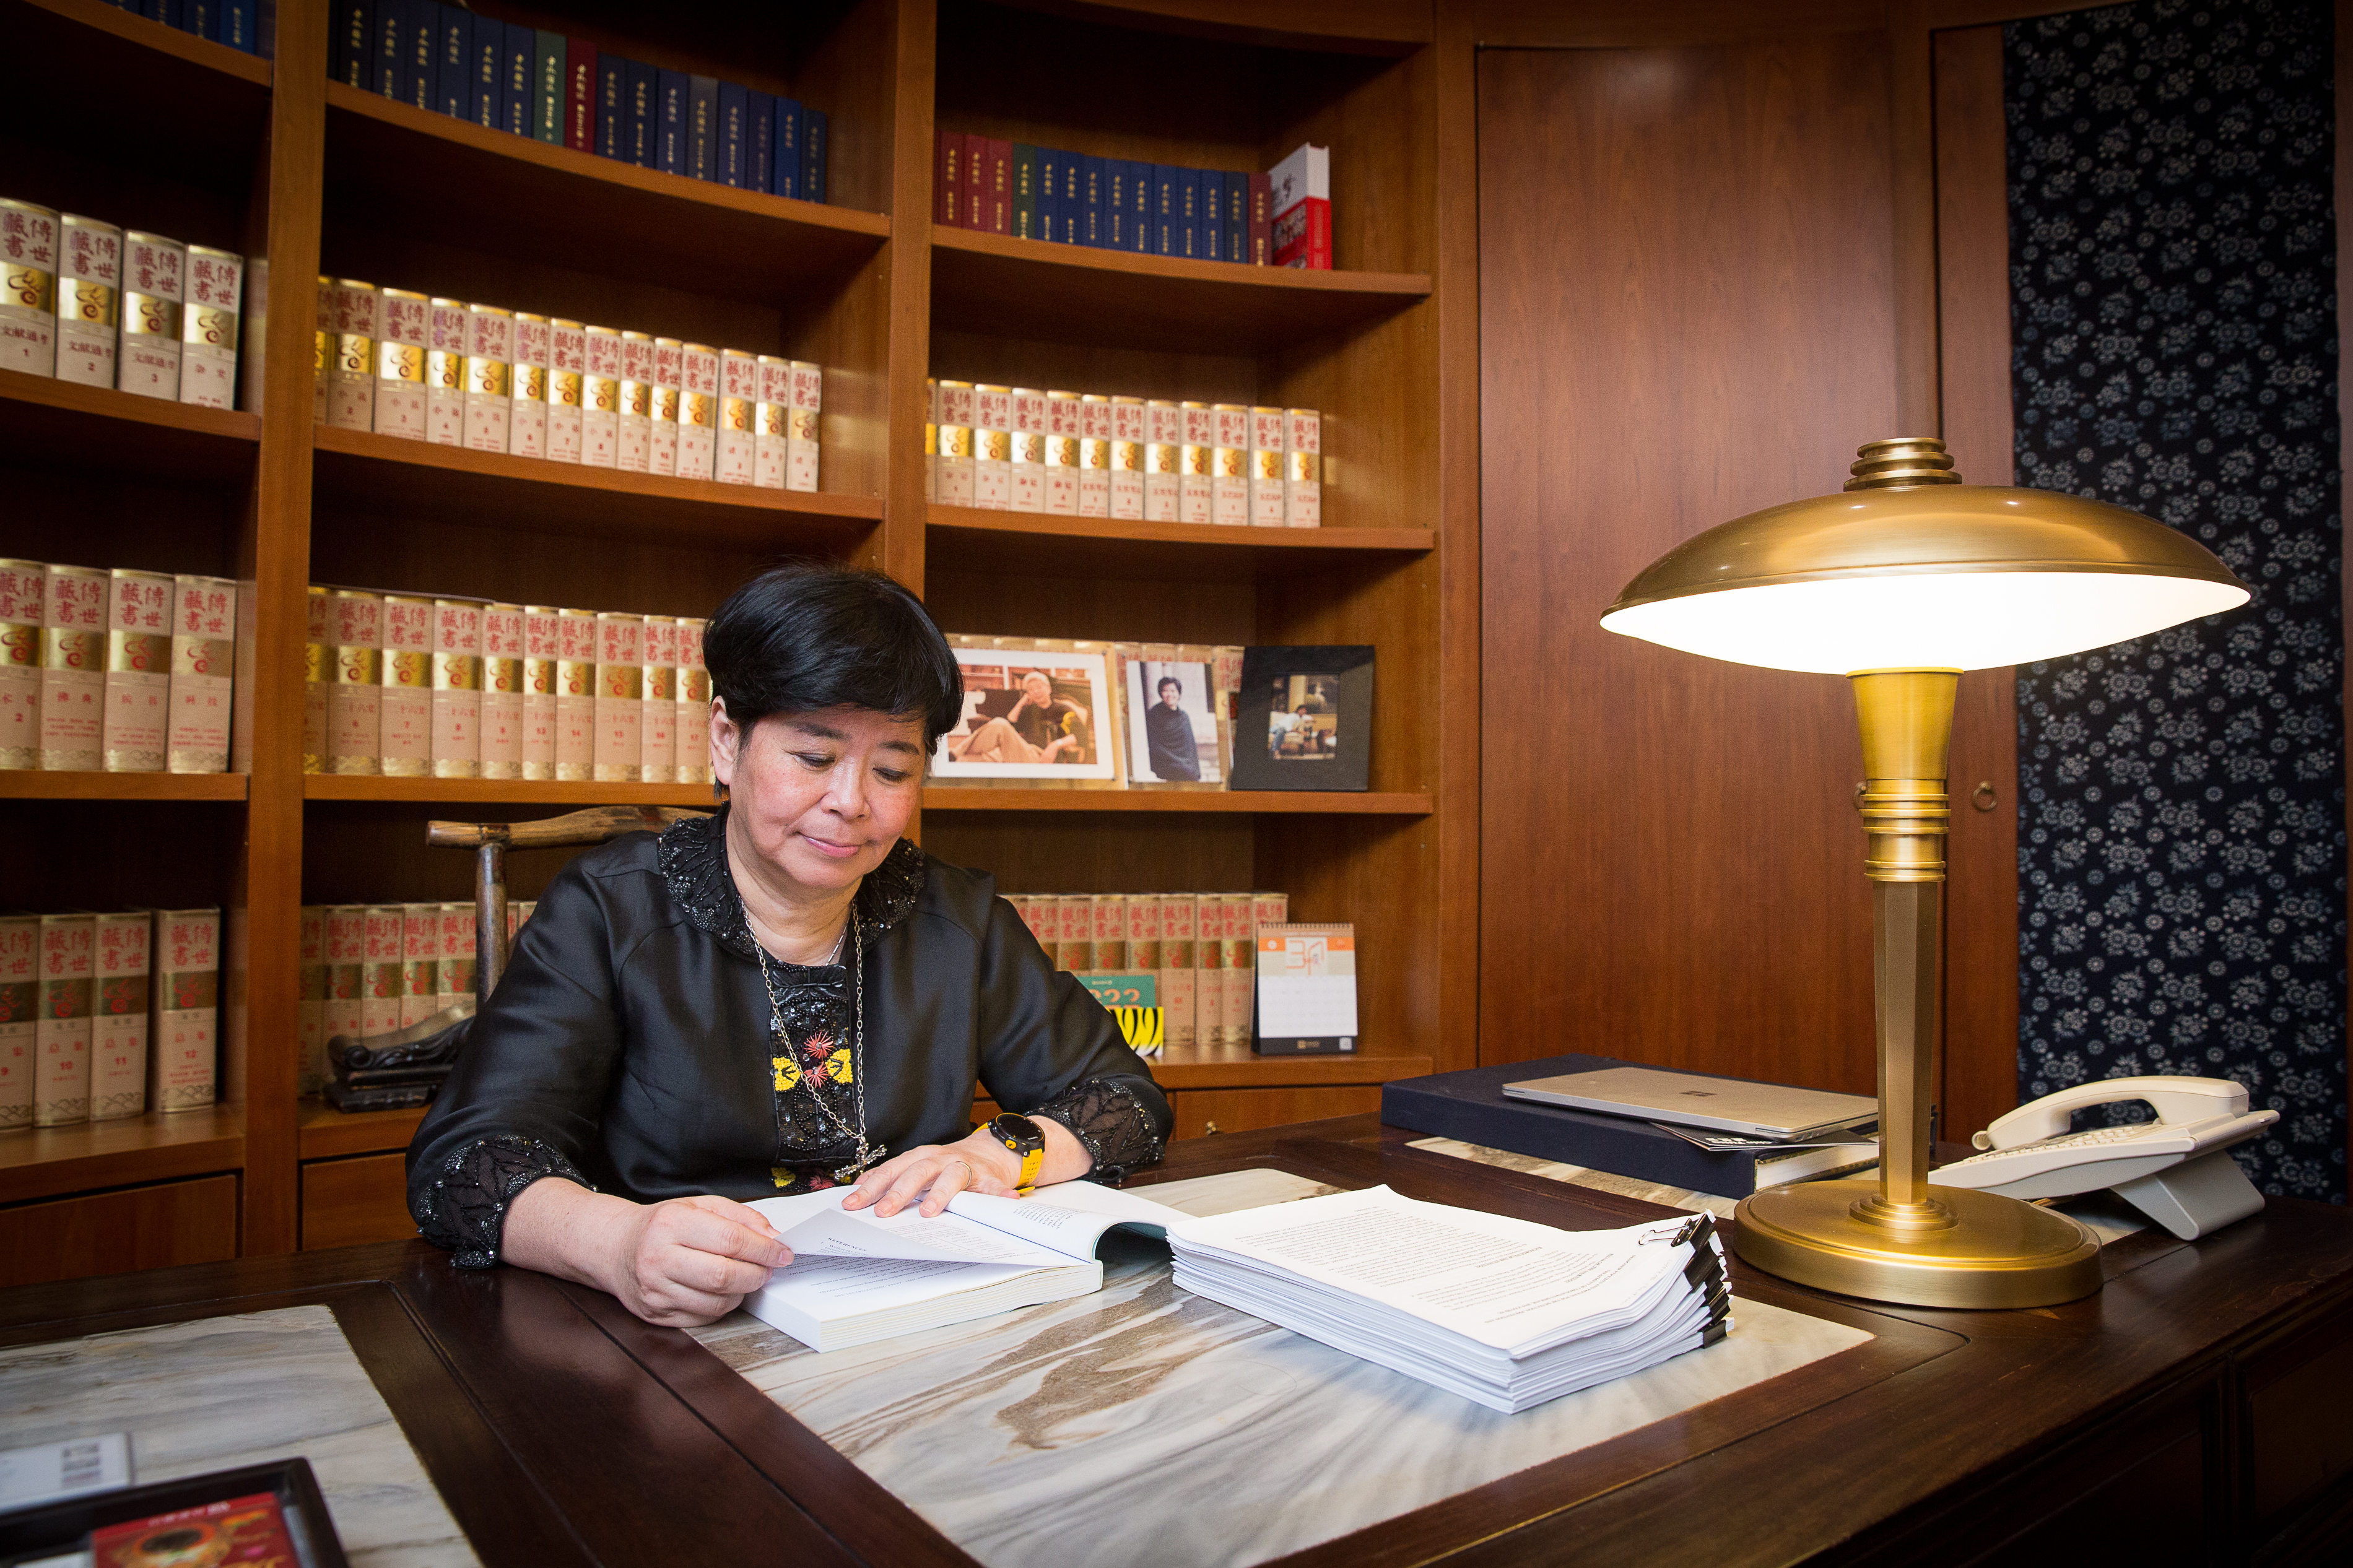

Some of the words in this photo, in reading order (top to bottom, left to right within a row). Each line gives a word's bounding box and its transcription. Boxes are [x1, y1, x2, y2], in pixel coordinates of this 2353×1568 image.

[185, 1050, 197, 1059] 12
[115, 1056, 126, 1065] 11
[60, 1061, 73, 1070] 10
[827, 1237, 867, 1252] REFERENCES
